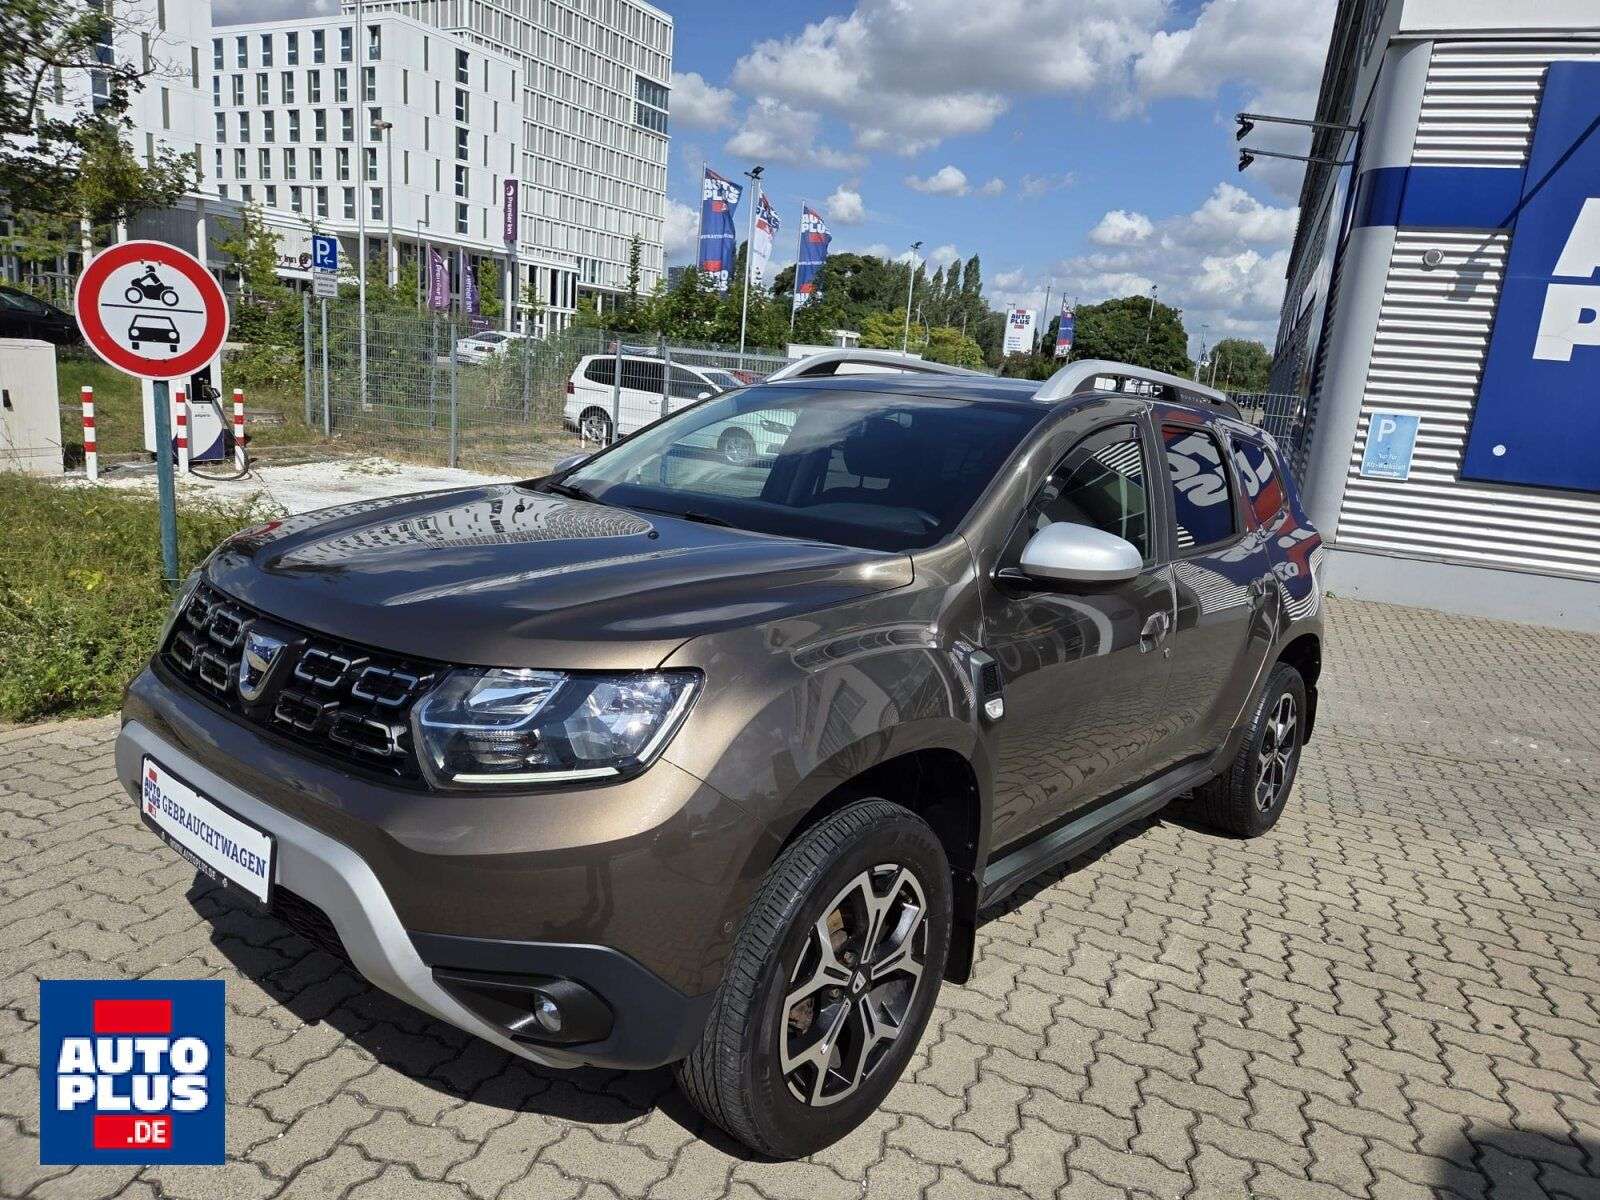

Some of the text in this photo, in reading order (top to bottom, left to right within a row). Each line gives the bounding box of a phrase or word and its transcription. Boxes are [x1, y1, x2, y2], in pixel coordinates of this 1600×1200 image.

[316, 239, 330, 264] P
[1377, 419, 1397, 442] P
[144, 777, 161, 796] AUTO
[144, 788, 161, 810] PLUS
[162, 795, 267, 879] GEBRAUCHTWAGEN
